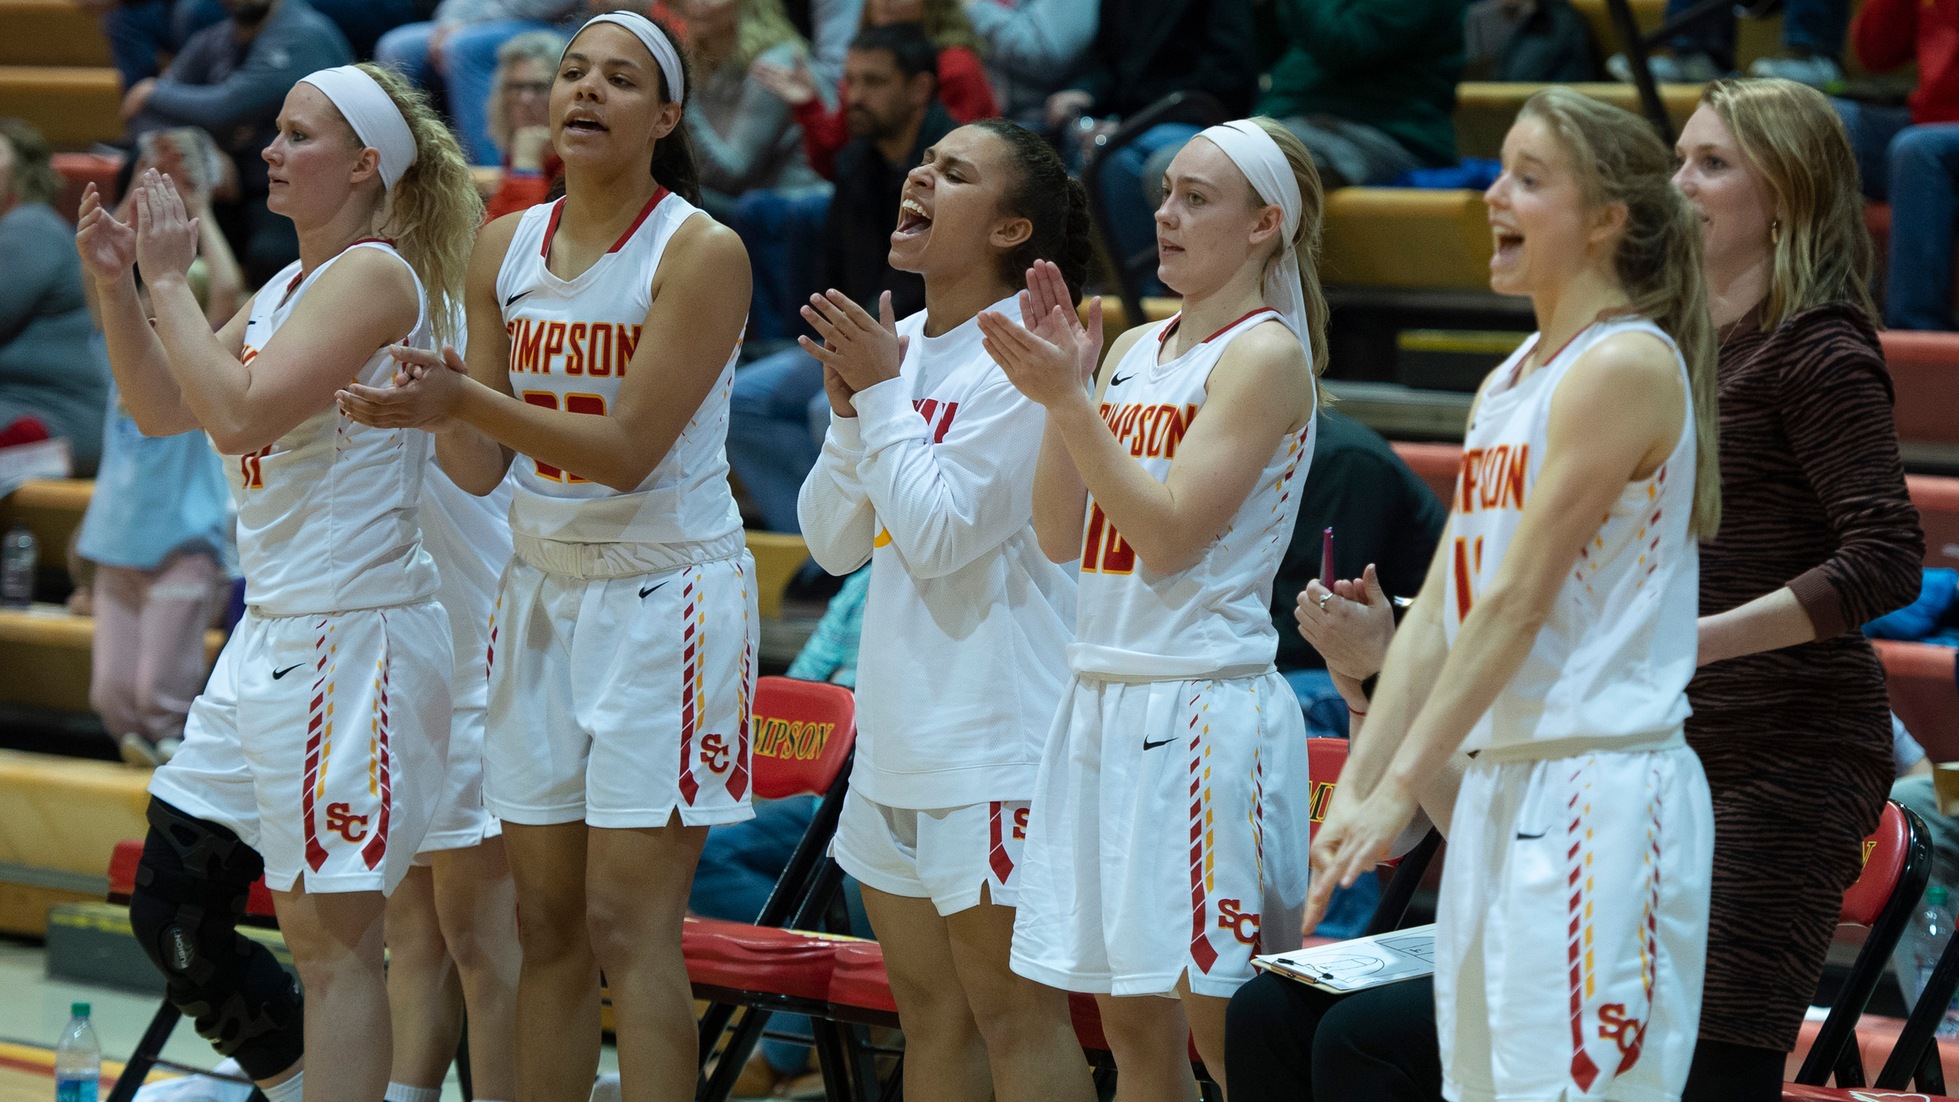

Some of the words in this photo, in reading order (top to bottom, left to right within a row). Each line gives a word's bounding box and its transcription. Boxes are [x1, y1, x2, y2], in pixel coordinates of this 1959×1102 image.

[699, 733, 730, 775] SC
[751, 713, 835, 760] MPSON
[326, 802, 368, 845] SC
[1012, 807, 1030, 841] S
[1217, 898, 1261, 946] SC
